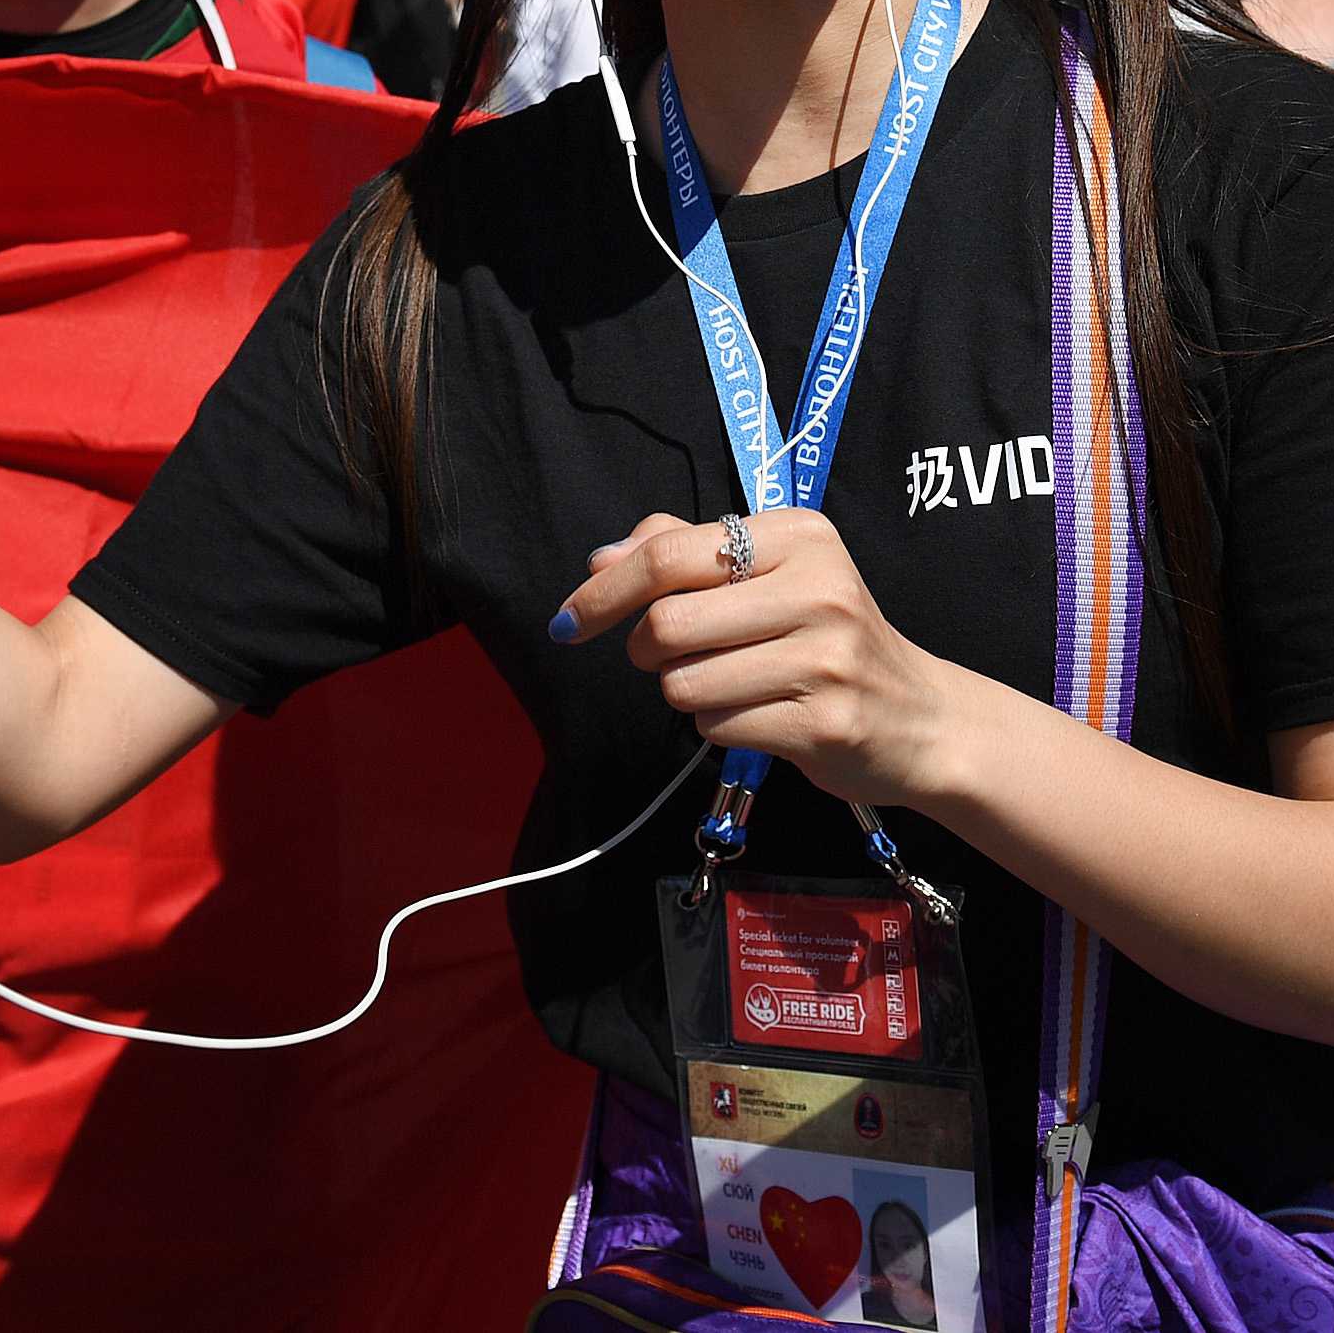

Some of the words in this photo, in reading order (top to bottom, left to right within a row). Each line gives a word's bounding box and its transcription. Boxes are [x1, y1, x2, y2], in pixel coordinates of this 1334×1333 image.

[884, 75, 929, 157] HOST
[913, 9, 949, 74] CITY
[708, 304, 750, 383] HOST
[739, 928, 771, 943] Special
[772, 931, 798, 945] ticket
[799, 932, 812, 945] for
[740, 959, 767, 972] билет
[782, 1000, 818, 1018] FREE
[820, 1002, 855, 1021] RIDE
[722, 1182, 755, 1203] СЮЙ
[727, 1223, 763, 1245] CHEN
[729, 1249, 766, 1271] ЧЭНЬ
